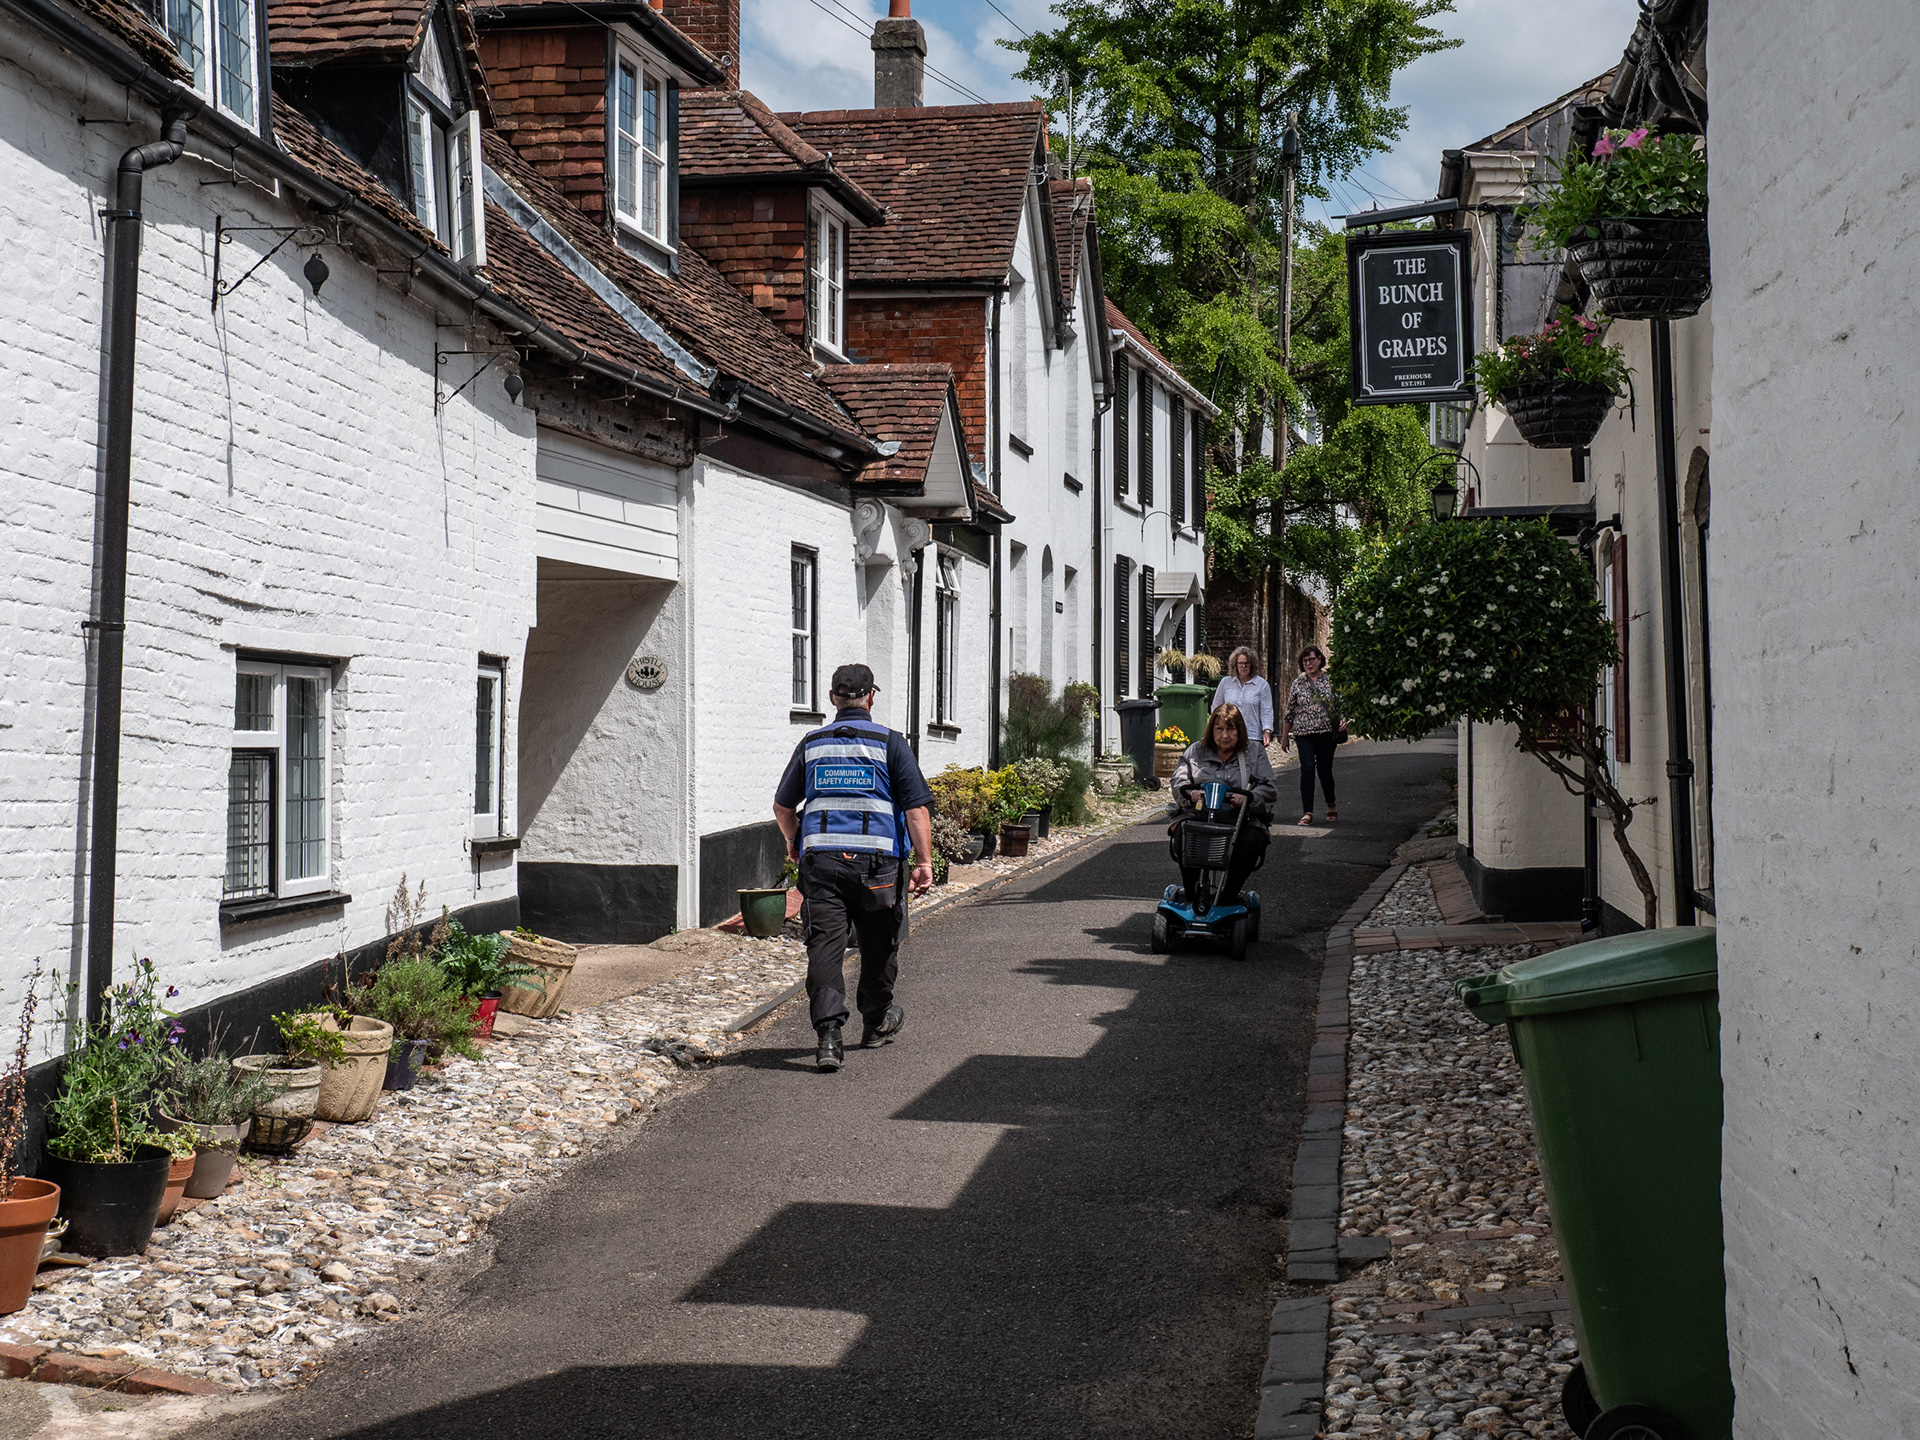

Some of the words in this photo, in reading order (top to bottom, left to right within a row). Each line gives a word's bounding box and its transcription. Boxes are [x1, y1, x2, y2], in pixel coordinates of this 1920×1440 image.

[1393, 258, 1426, 275] THE
[1378, 283, 1443, 305] BUNCH
[1401, 312, 1422, 329] OF
[1378, 336, 1447, 358] GRAPES
[1394, 373, 1432, 381] FREEHOUSE
[630, 657, 664, 671] THISTLE
[631, 675, 664, 687] HOUSE
[825, 769, 865, 777] COMMUNITY
[818, 777, 842, 785] SAFETY
[844, 777, 871, 785] OFFICER
